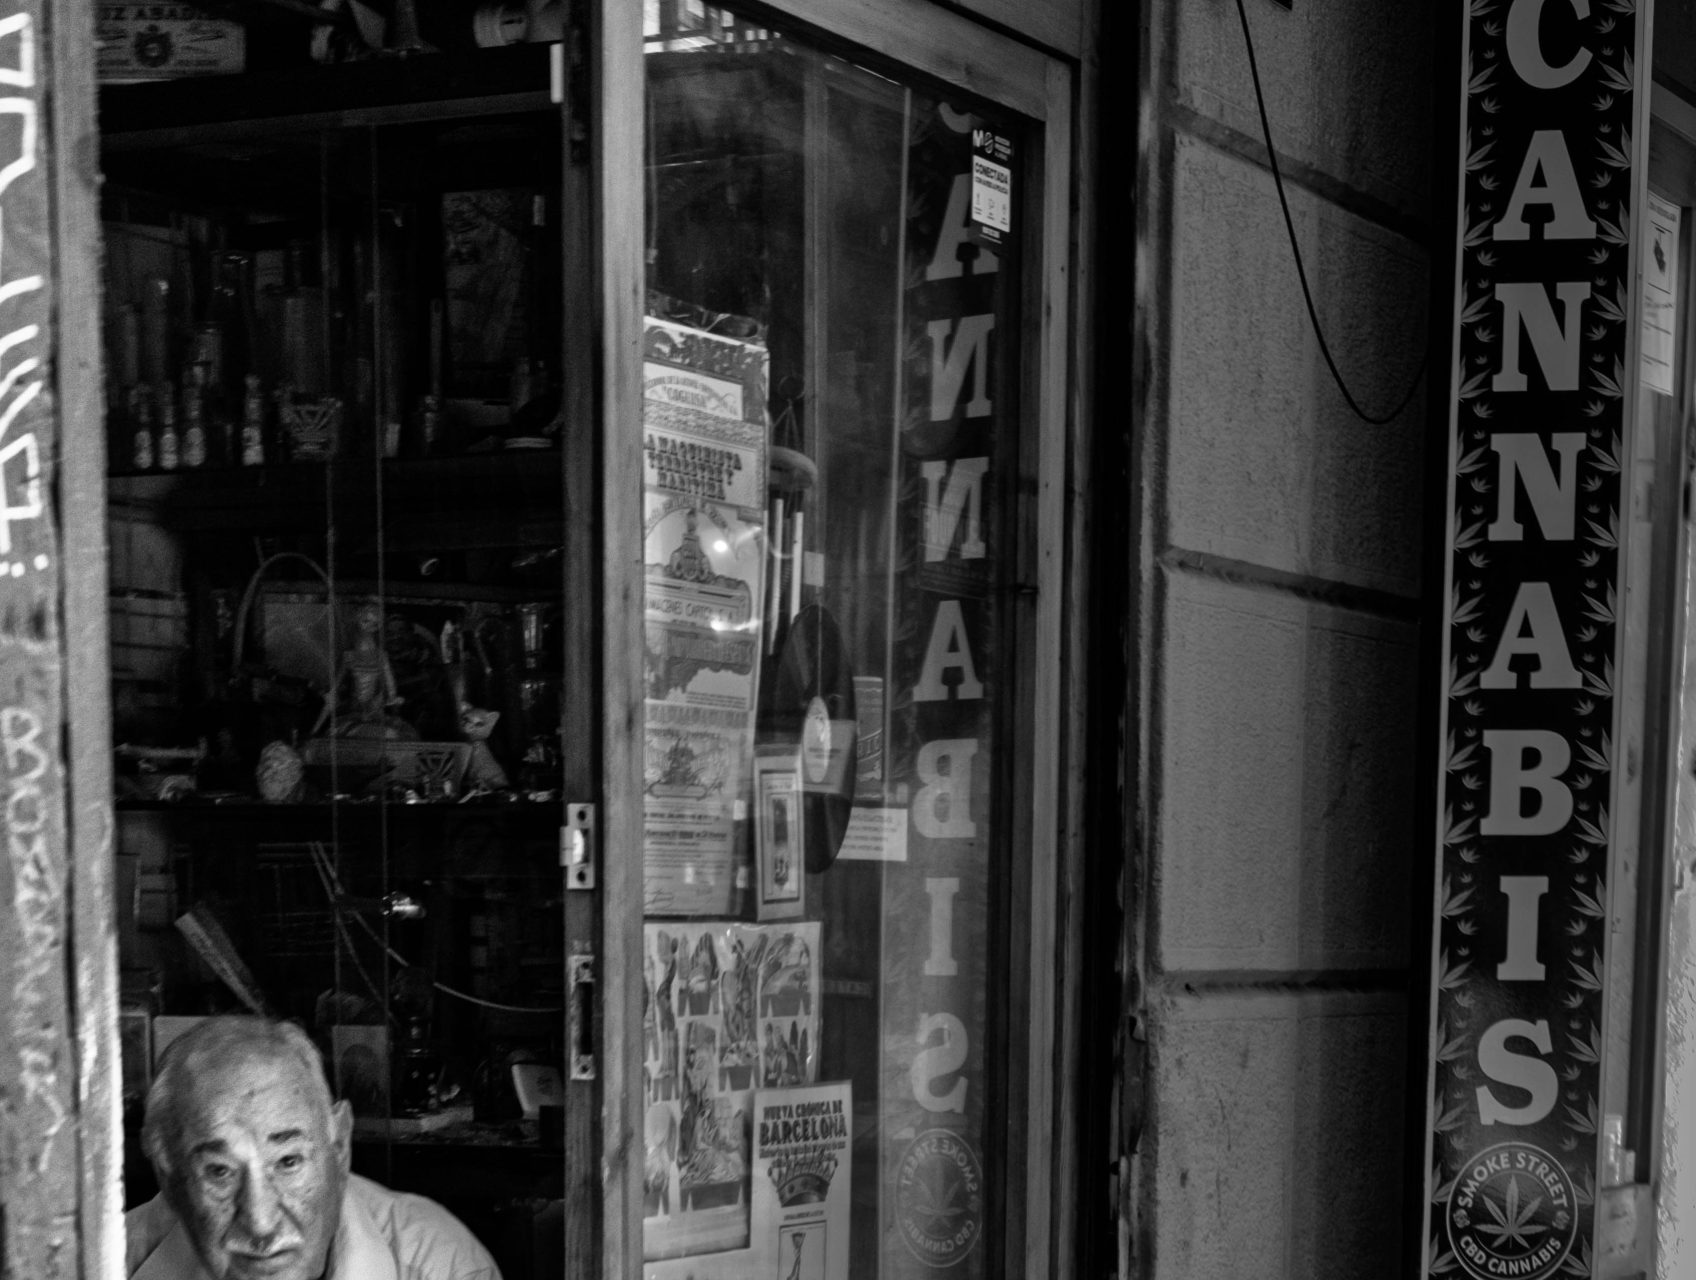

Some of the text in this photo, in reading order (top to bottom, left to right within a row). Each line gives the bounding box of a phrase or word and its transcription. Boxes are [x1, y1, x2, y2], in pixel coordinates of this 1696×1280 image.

[1475, 0, 1597, 1126] CANNABIS
[759, 1114, 847, 1146] BARCELONA
[763, 1104, 794, 1120] NUEVA
[1458, 1151, 1569, 1208] SMOKE STREET
[1459, 1235, 1562, 1275] CBD CANNABIS
